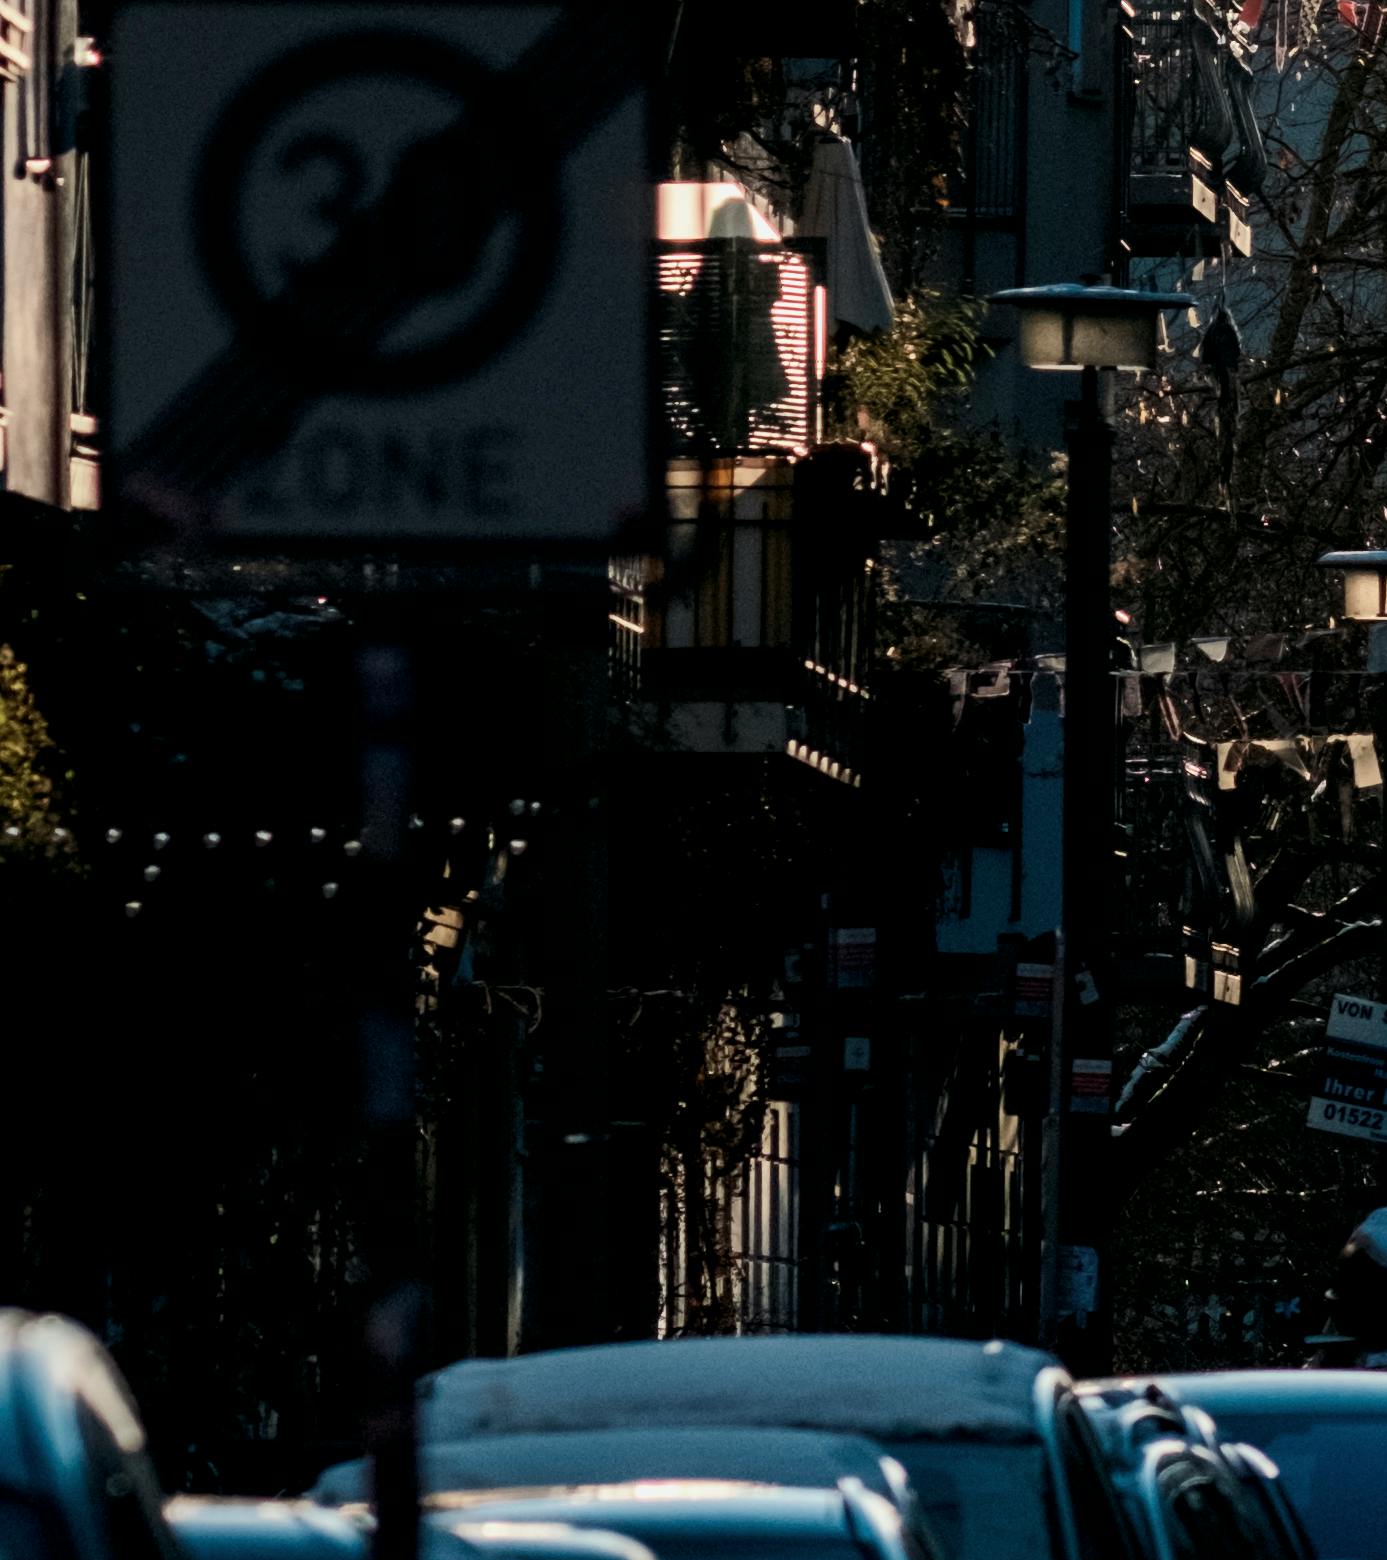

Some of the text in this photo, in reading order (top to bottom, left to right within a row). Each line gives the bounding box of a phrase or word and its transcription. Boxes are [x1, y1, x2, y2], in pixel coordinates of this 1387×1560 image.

[1338, 1000, 1373, 1020] VON
[1323, 1077, 1376, 1102] Ihrer
[1324, 1104, 1384, 1130] 01522
